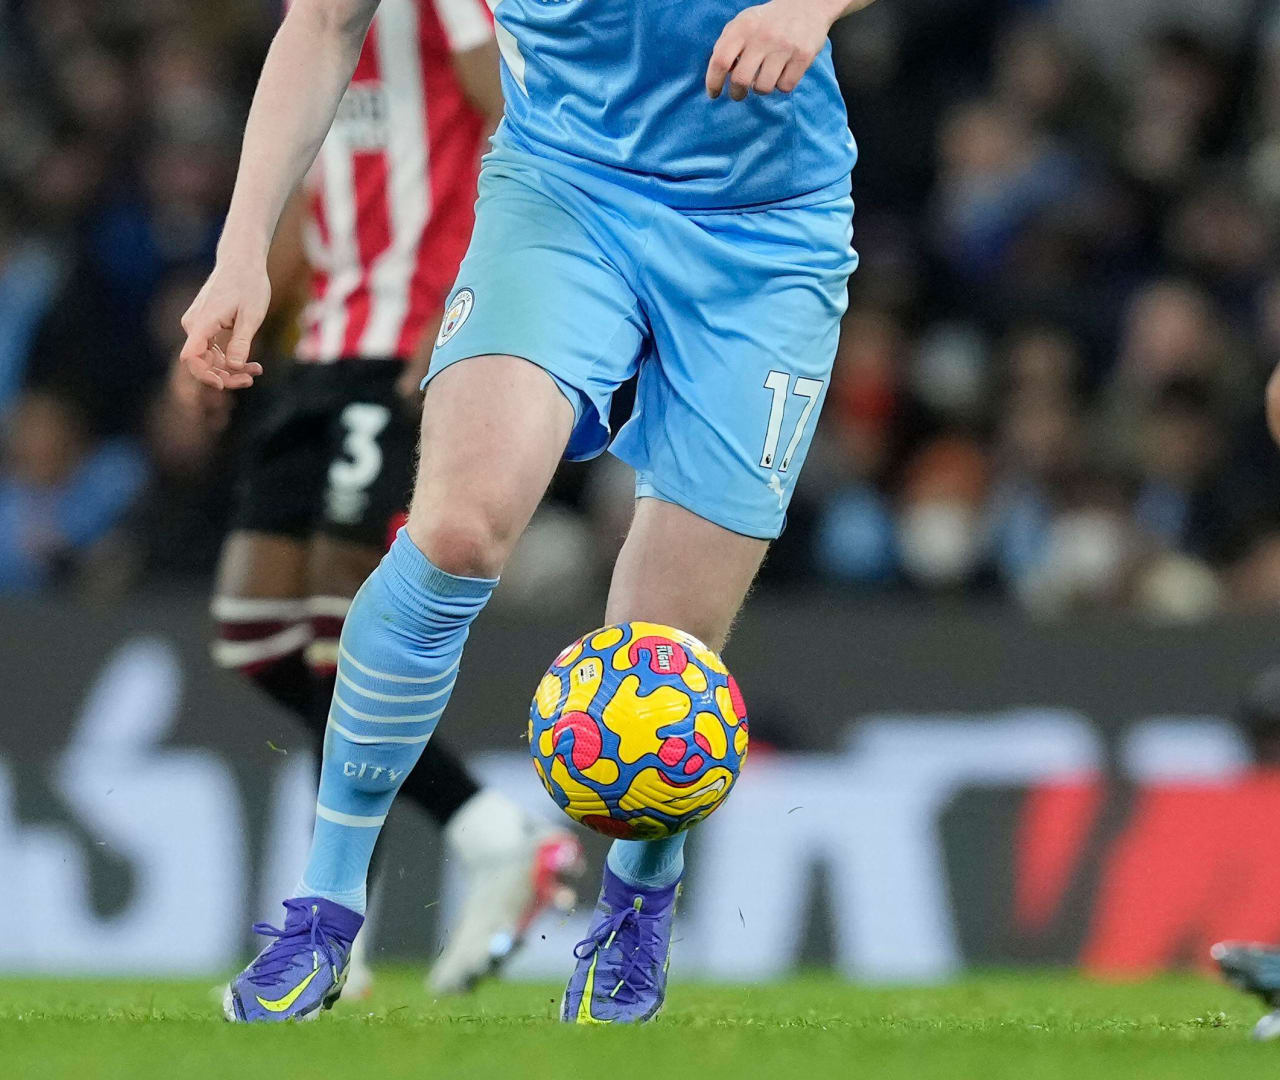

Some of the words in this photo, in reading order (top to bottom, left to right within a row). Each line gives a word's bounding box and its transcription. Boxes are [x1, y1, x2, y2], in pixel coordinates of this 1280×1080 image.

[327, 402, 391, 489] 3
[758, 369, 825, 473] 17
[655, 644, 671, 671] FLIGHT
[343, 761, 404, 782] CITY
